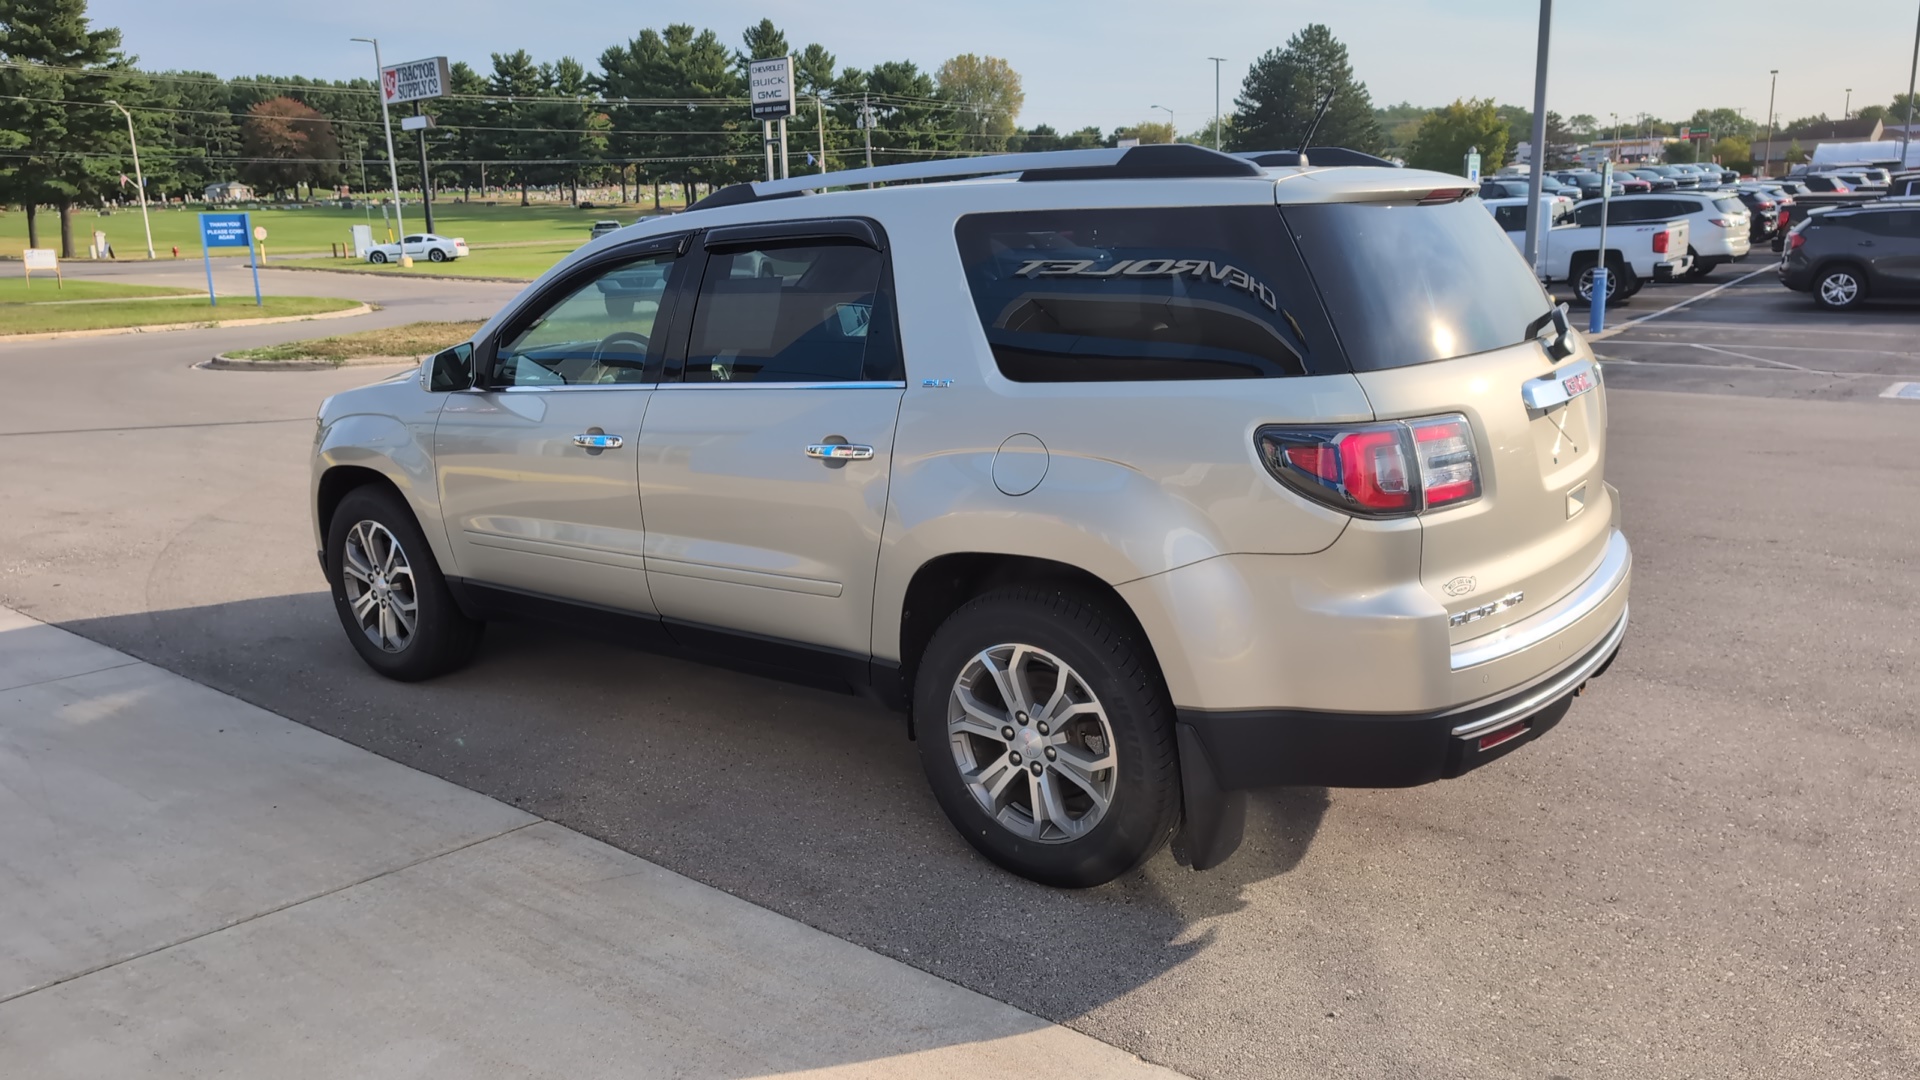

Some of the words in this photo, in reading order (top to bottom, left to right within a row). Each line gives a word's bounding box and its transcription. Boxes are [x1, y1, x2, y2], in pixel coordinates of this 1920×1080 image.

[396, 61, 436, 82] TRACTOR
[752, 64, 784, 74] CHEVROLET
[752, 77, 785, 87] BUICK
[397, 80, 427, 99] SUPPLY
[758, 90, 782, 100] GMC
[922, 379, 955, 389] SLT
[1565, 372, 1593, 397] GMC
